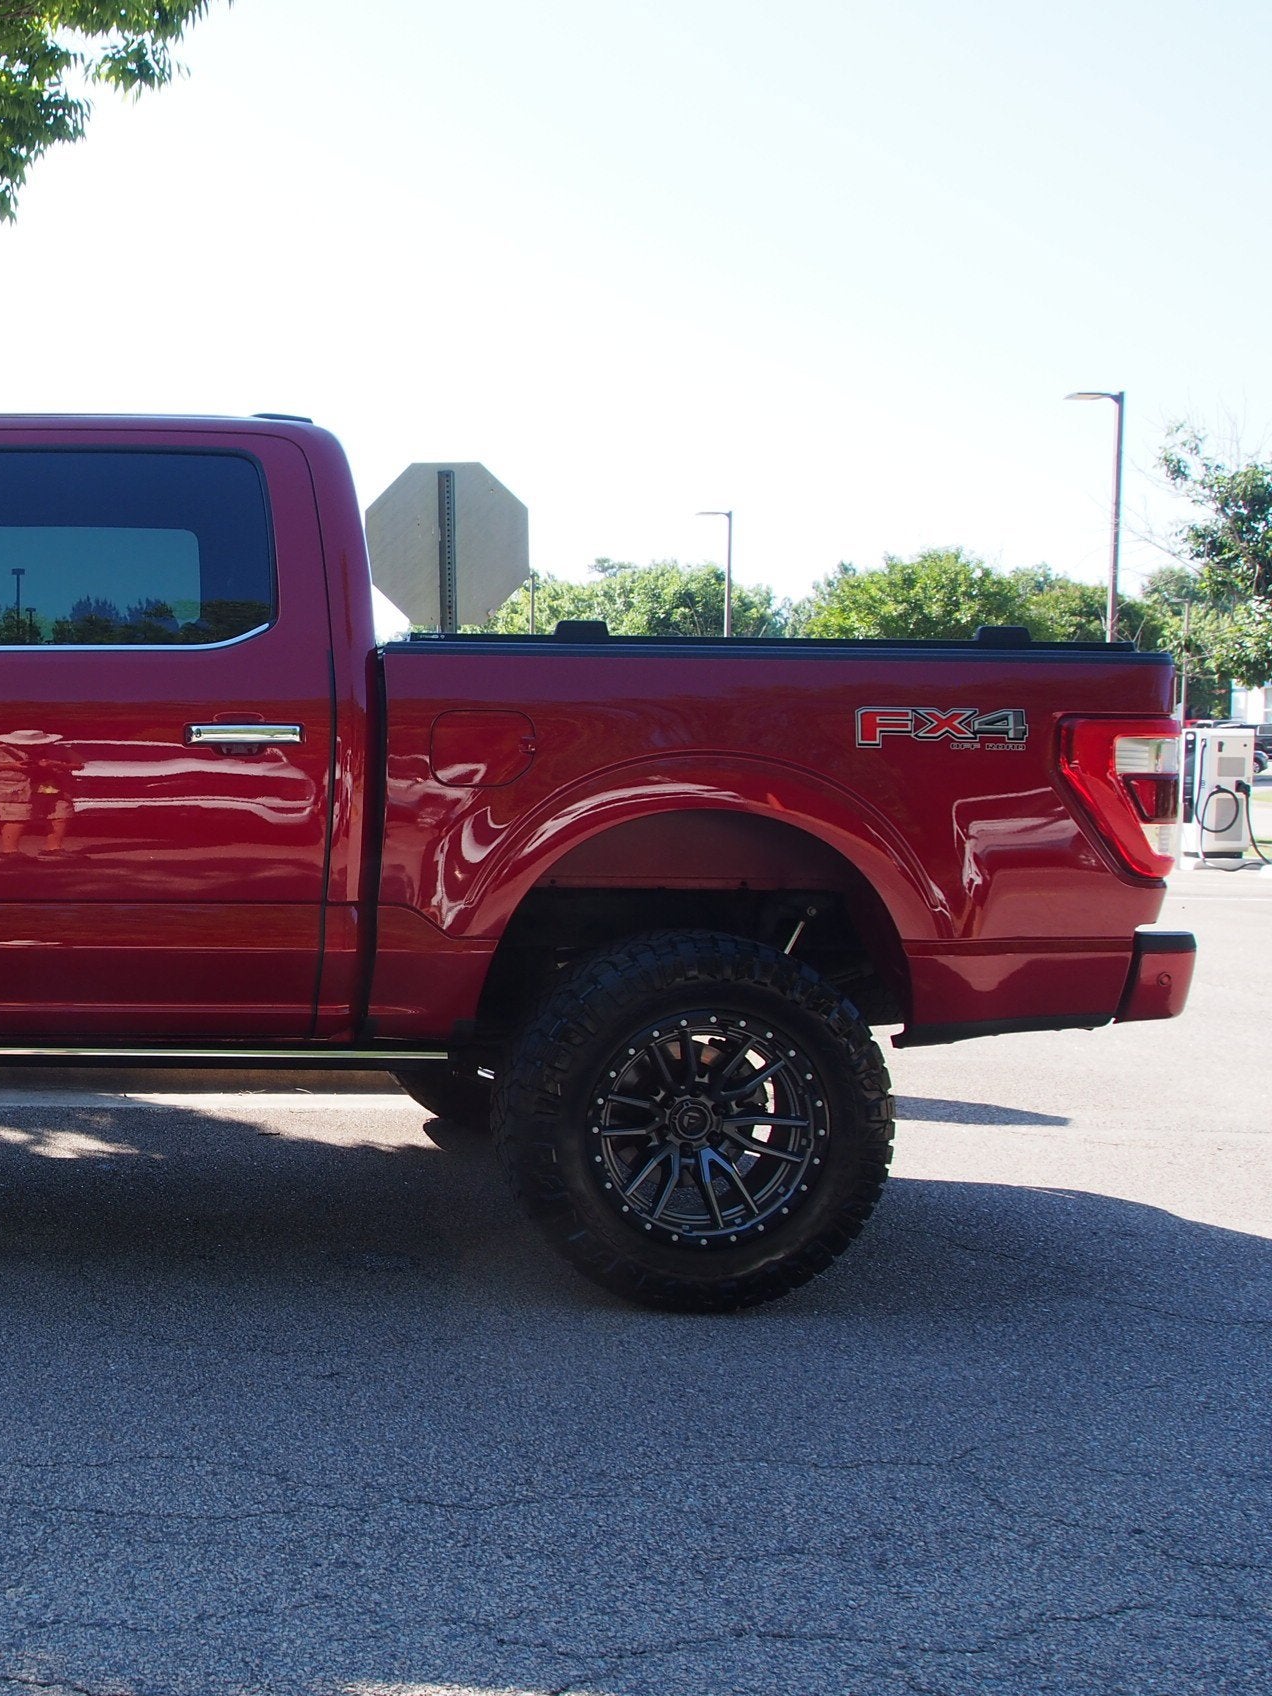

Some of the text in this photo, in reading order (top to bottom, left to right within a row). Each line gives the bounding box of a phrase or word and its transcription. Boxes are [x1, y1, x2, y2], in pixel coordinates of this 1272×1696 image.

[855, 706, 1028, 748] FX4
[949, 742, 1026, 751] OFF ROAD
